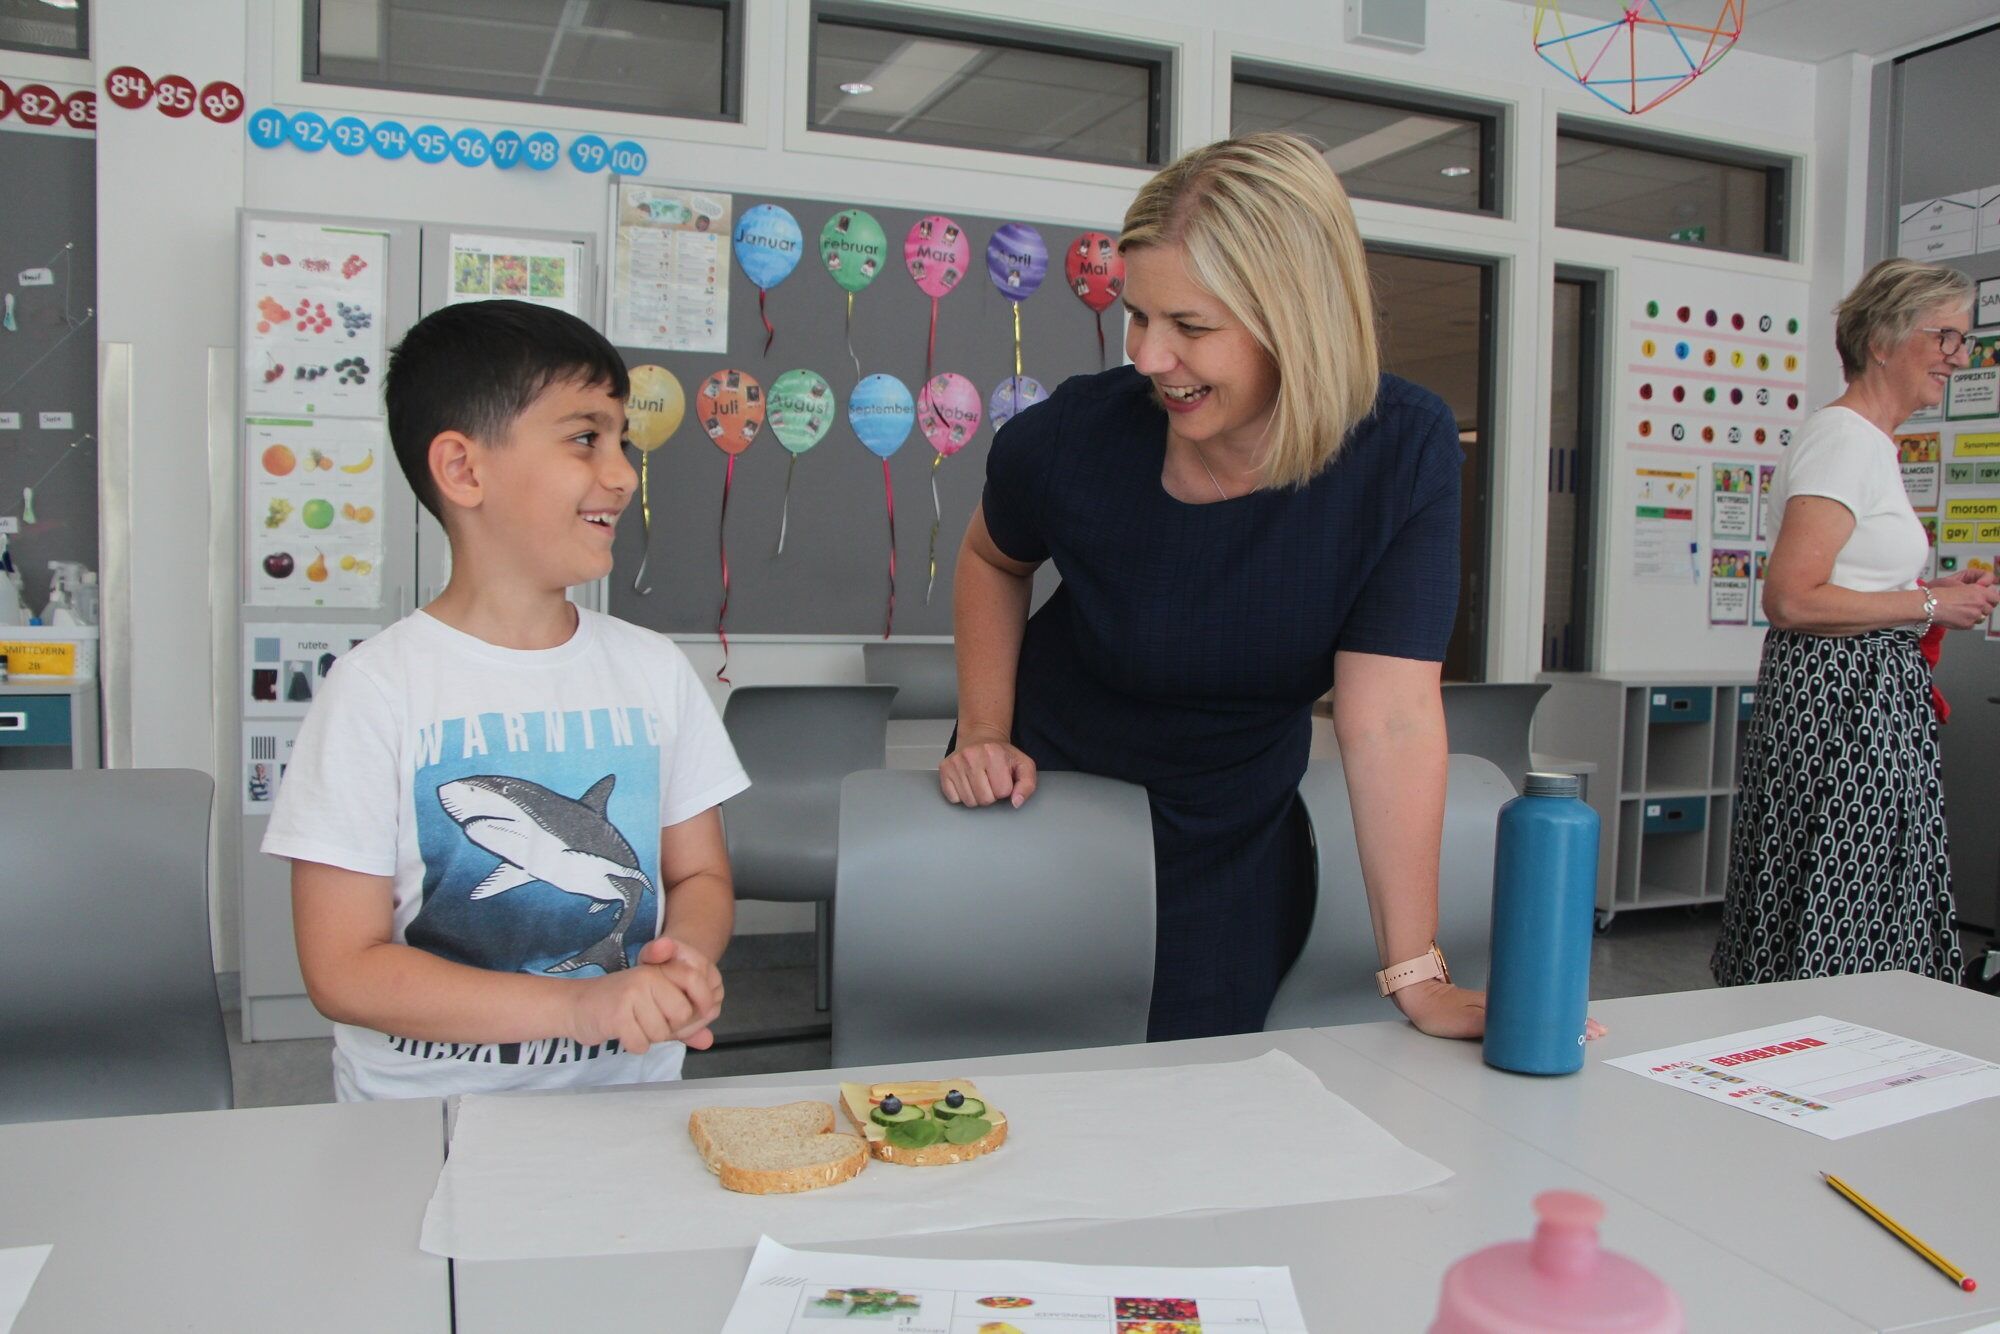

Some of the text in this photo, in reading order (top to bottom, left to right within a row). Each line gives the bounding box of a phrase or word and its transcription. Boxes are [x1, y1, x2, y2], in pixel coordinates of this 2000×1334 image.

[110, 74, 239, 117] 84 85 86
[20, 92, 56, 119] 82
[68, 99, 96, 122] 83
[257, 117, 643, 172] 91 92 93 94 95 96 97 98 99 100
[734, 228, 797, 253] Januar
[823, 238, 879, 255] Februar
[916, 246, 956, 264] Mars
[1079, 260, 1108, 276] Mai
[628, 395, 664, 412] Juni
[711, 399, 739, 415] Juli
[770, 394, 830, 415] August
[849, 402, 913, 417] September
[1950, 467, 1968, 480] tyv
[1951, 503, 1998, 514] morsom
[1946, 527, 1969, 540] gøy
[2, 645, 66, 656] SMITTEVERN
[297, 640, 329, 651] rutete
[28, 661, 41, 671] 2B
[414, 706, 660, 770] WARNING
